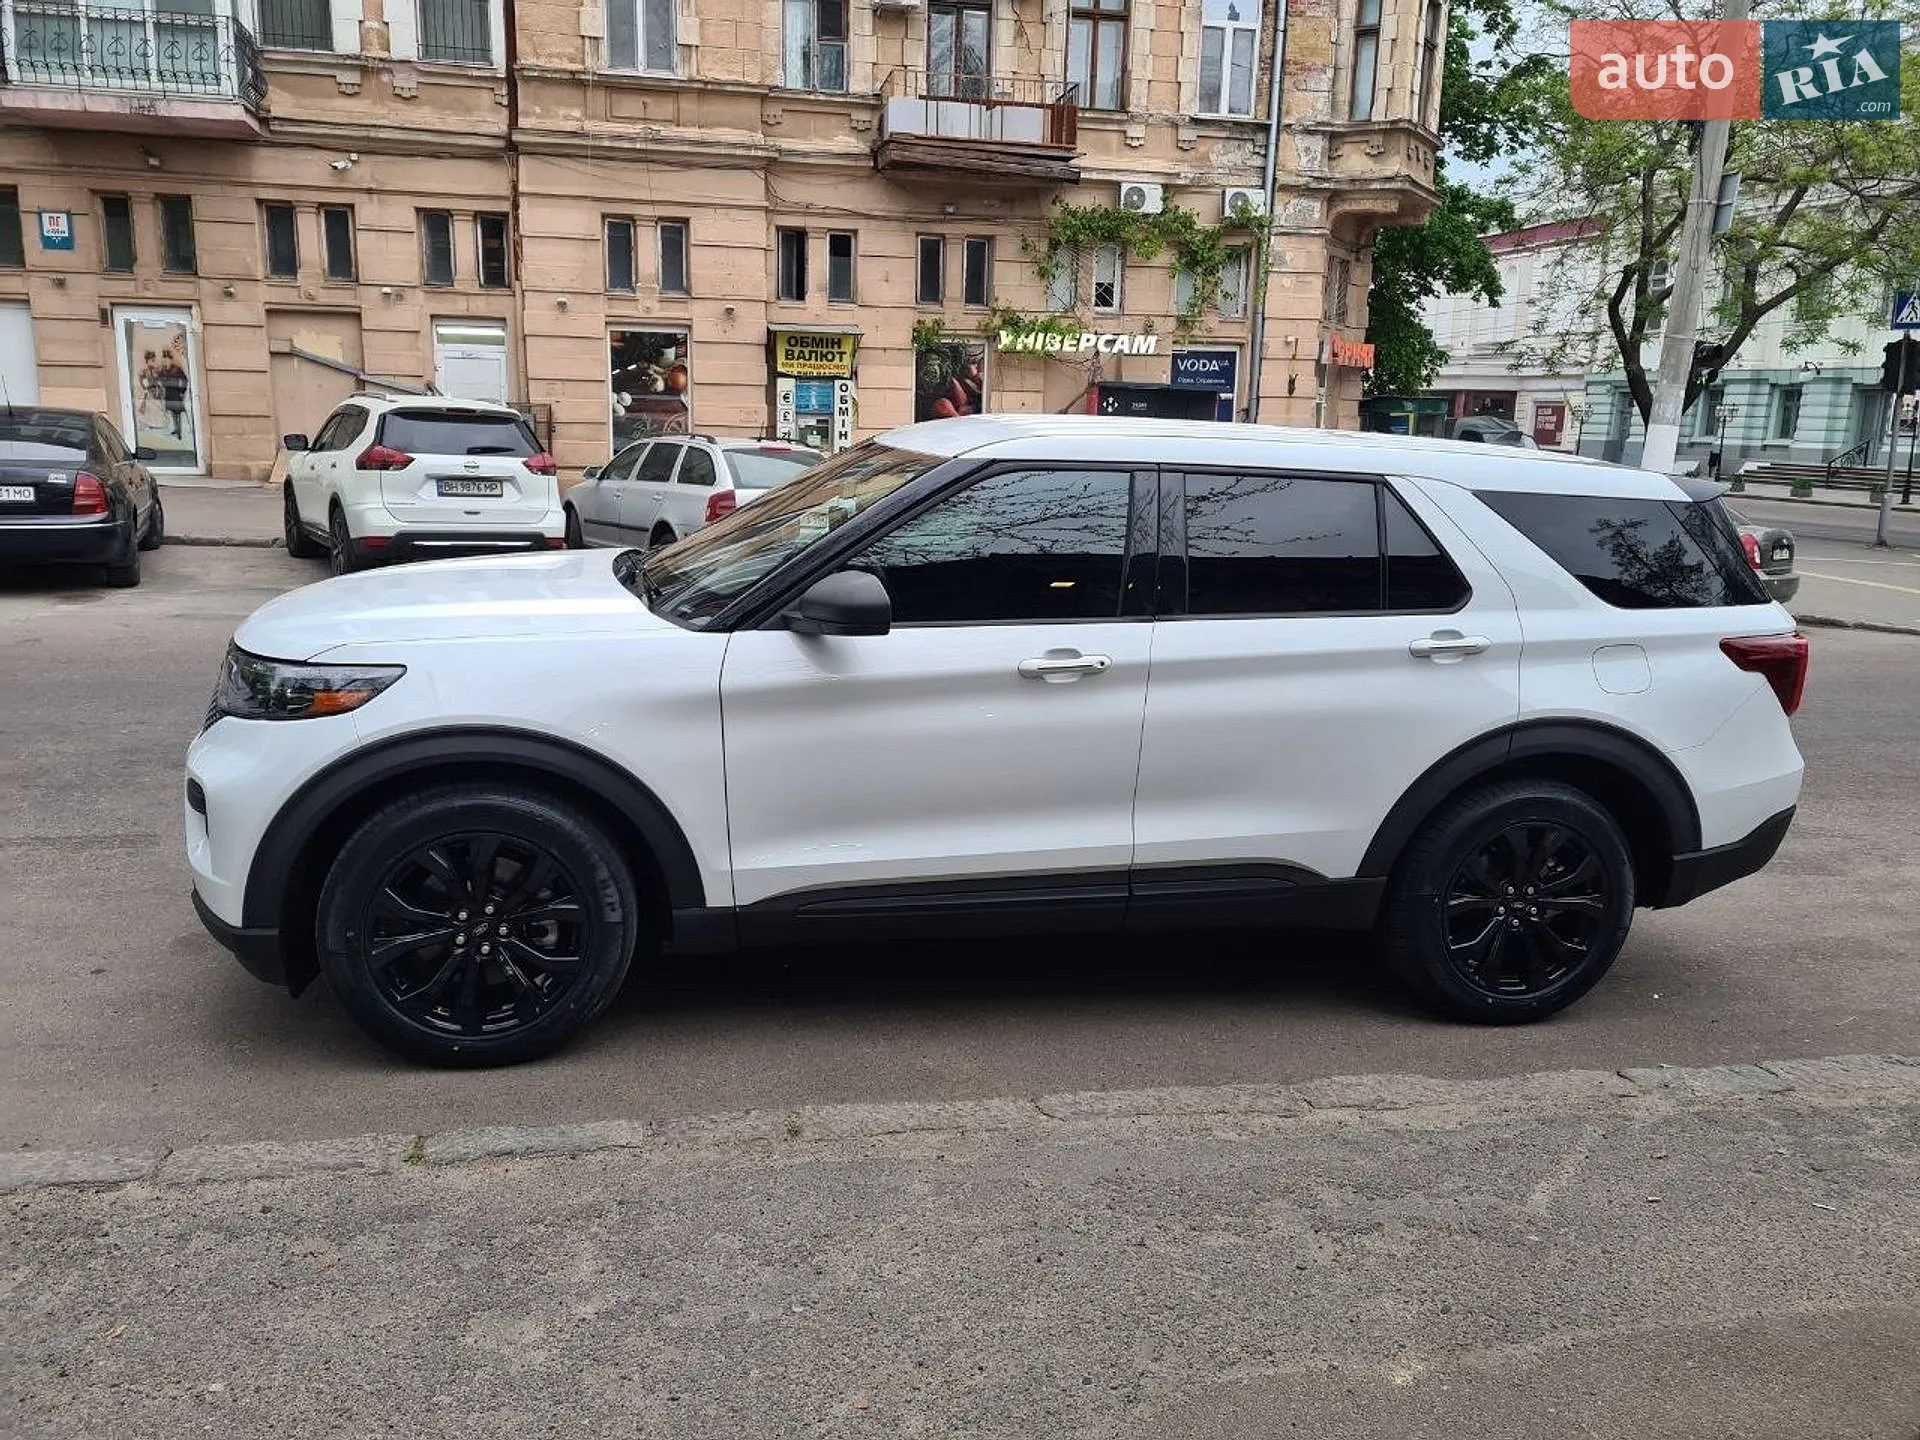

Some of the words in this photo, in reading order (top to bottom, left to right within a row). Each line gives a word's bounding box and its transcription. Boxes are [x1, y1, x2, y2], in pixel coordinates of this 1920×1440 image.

[787, 335, 842, 349] ОБМІН
[997, 330, 1159, 355] УНІВЕРСАМ
[784, 348, 847, 362] ВАЛЮТ
[1177, 358, 1220, 372] VODA
[838, 383, 849, 440] ОБМІН
[13, 489, 31, 498] MO
[443, 481, 458, 492] BH
[483, 482, 498, 493] MP
